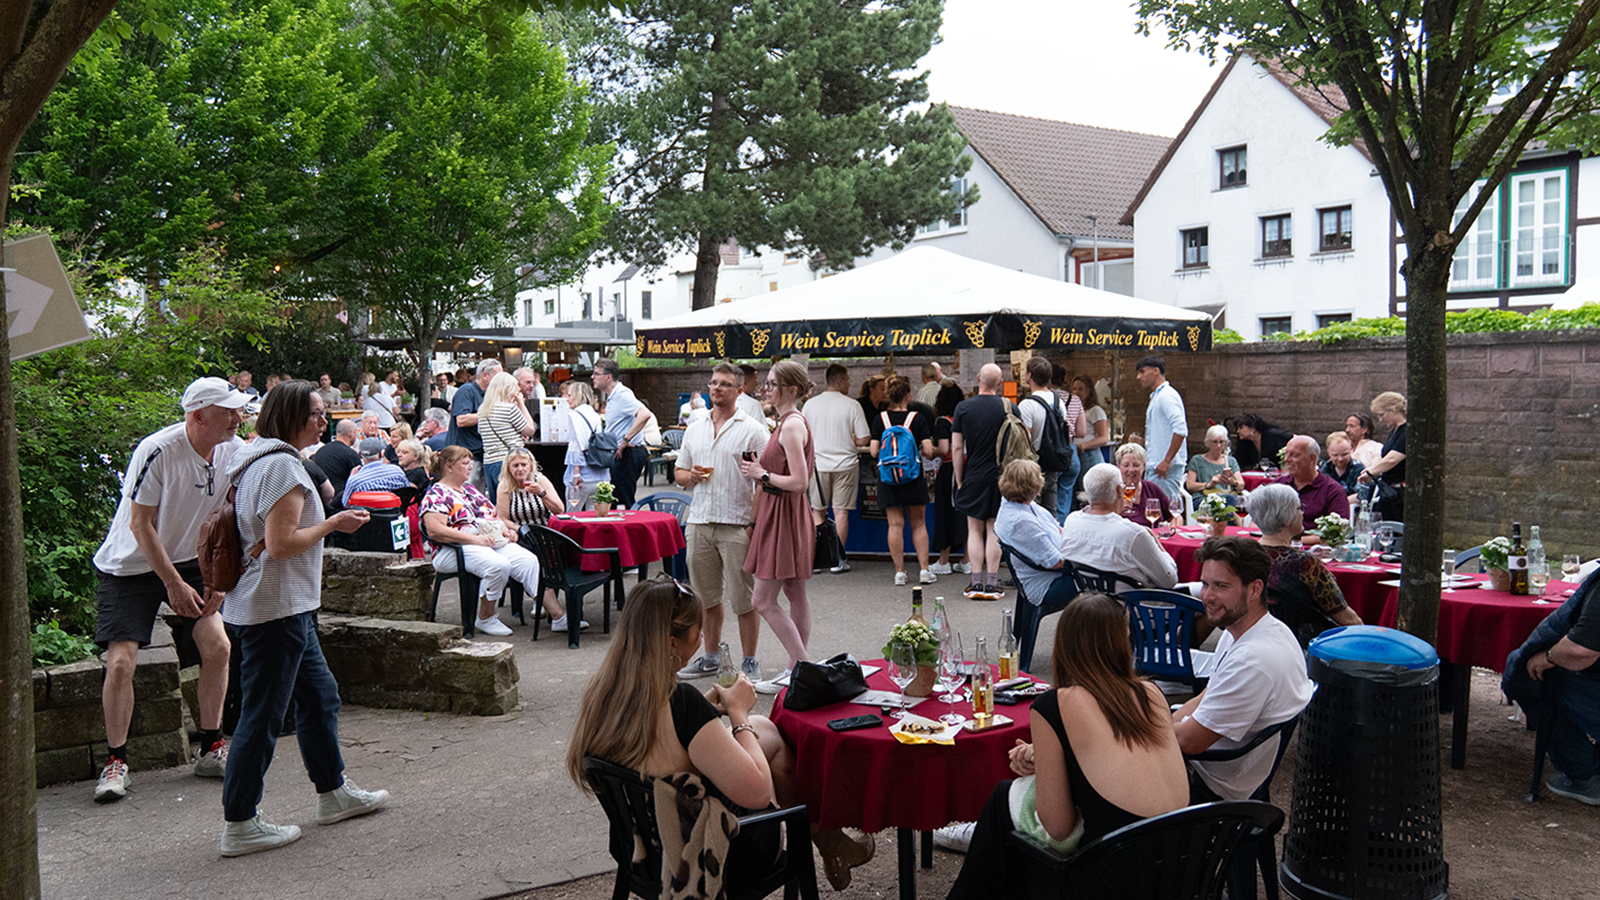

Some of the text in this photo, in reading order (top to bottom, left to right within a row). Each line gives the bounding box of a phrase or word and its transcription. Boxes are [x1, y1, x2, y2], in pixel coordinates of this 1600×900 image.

[647, 339, 711, 357] Wein Service Taplick
[781, 329, 951, 349] Wein Service Taplick
[1051, 328, 1178, 350] Wein Service Taplick
